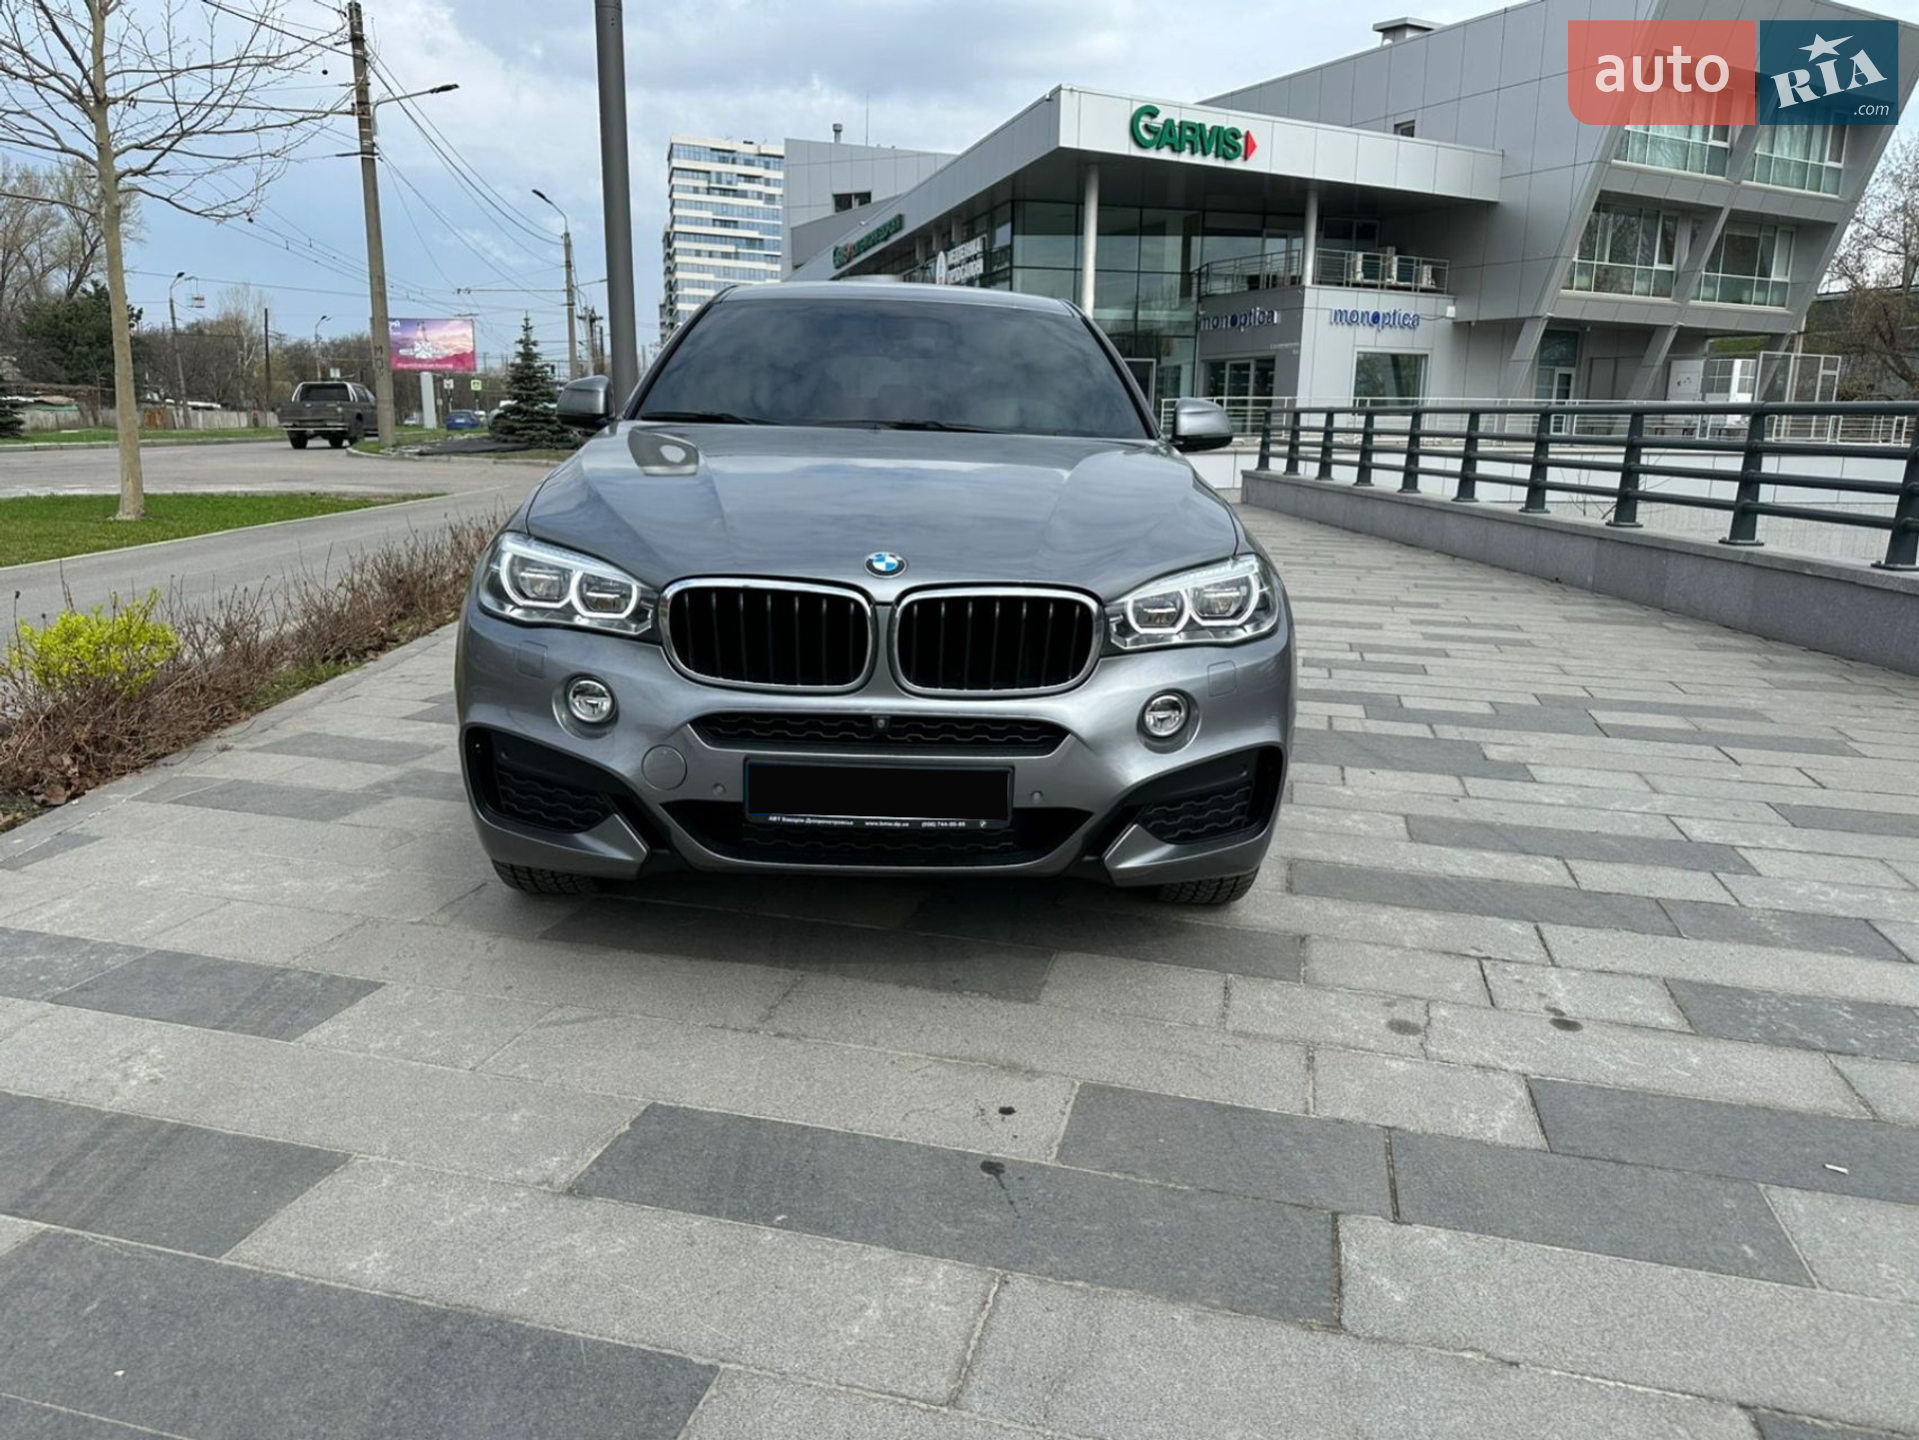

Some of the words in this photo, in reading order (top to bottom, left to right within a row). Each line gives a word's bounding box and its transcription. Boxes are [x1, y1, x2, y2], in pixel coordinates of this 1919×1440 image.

[1130, 104, 1243, 160] GARVIS
[1200, 306, 1279, 332] monoptica
[1331, 308, 1421, 332] monoptica
